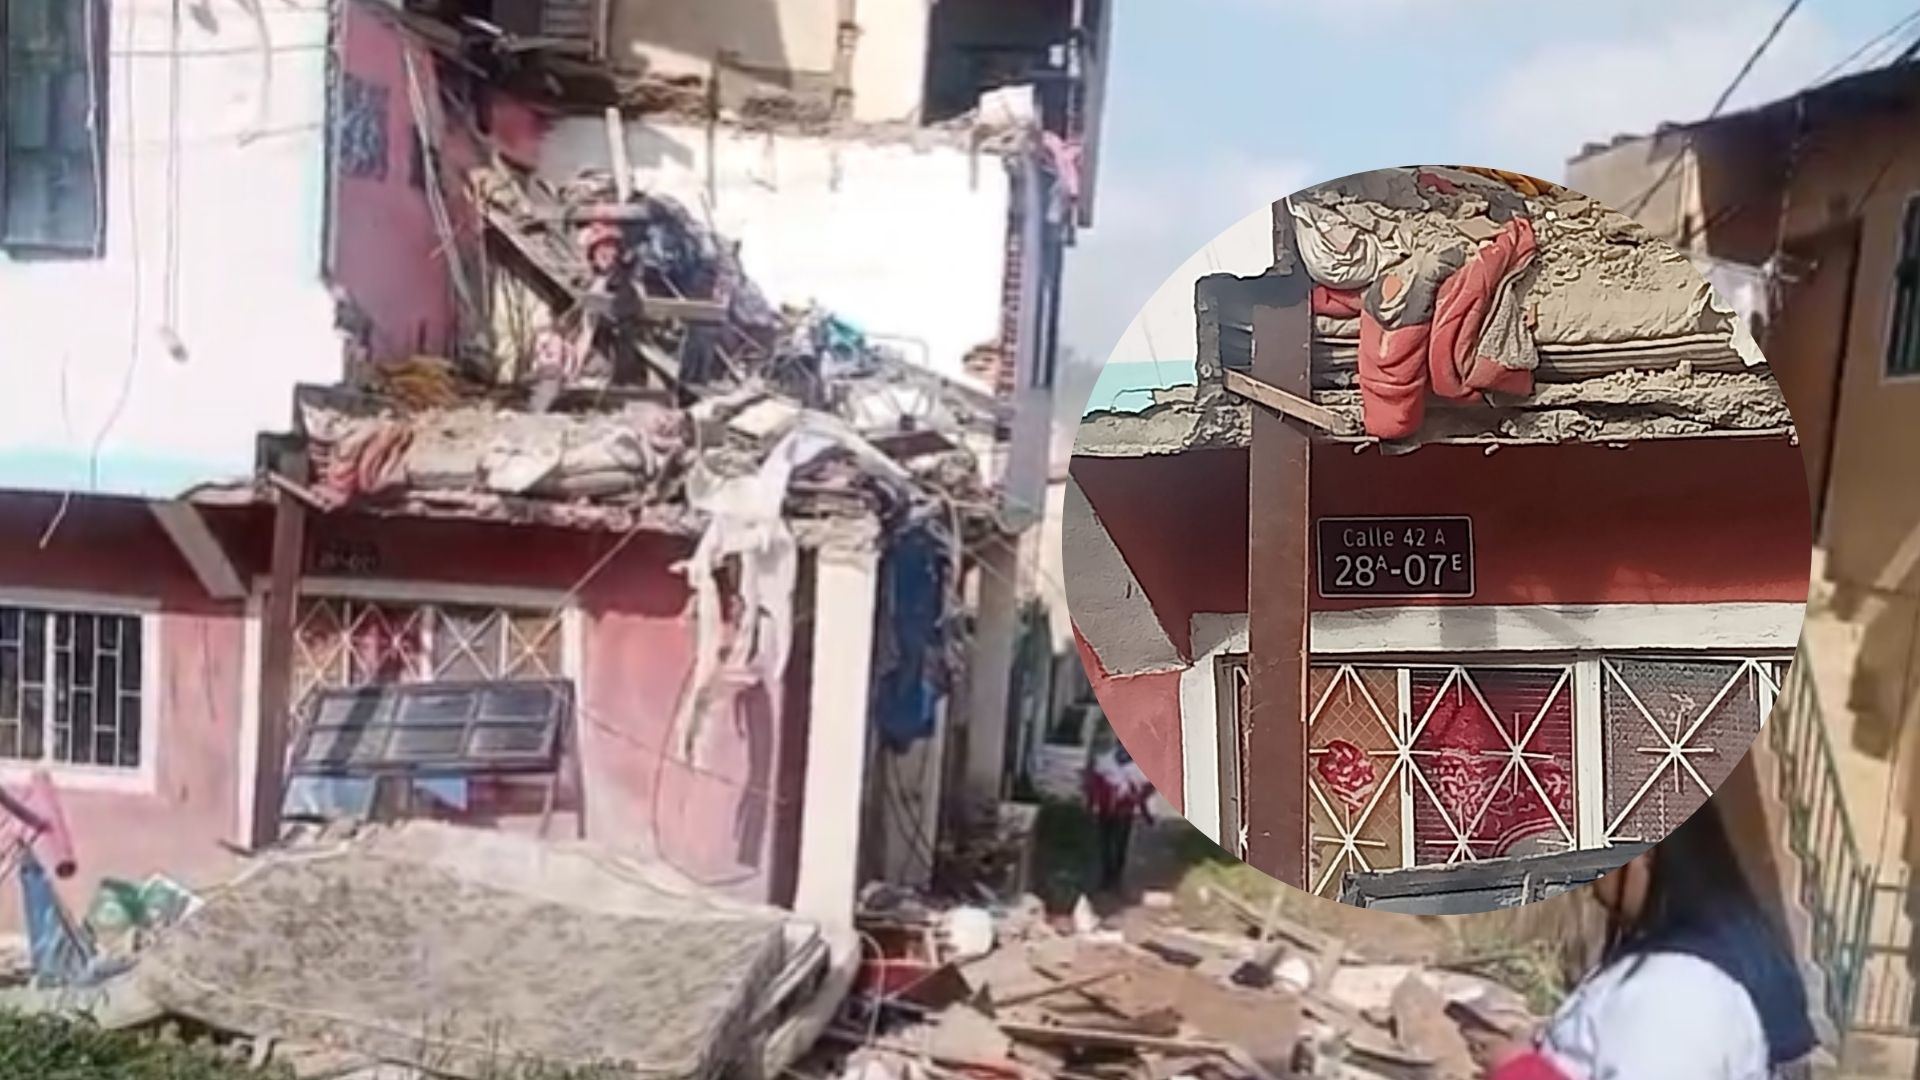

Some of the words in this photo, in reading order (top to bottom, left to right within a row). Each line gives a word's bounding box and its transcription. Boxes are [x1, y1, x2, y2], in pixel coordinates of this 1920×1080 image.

[1343, 527, 1394, 547] Calle
[1403, 527, 1426, 547] 42
[1434, 528, 1446, 545] A
